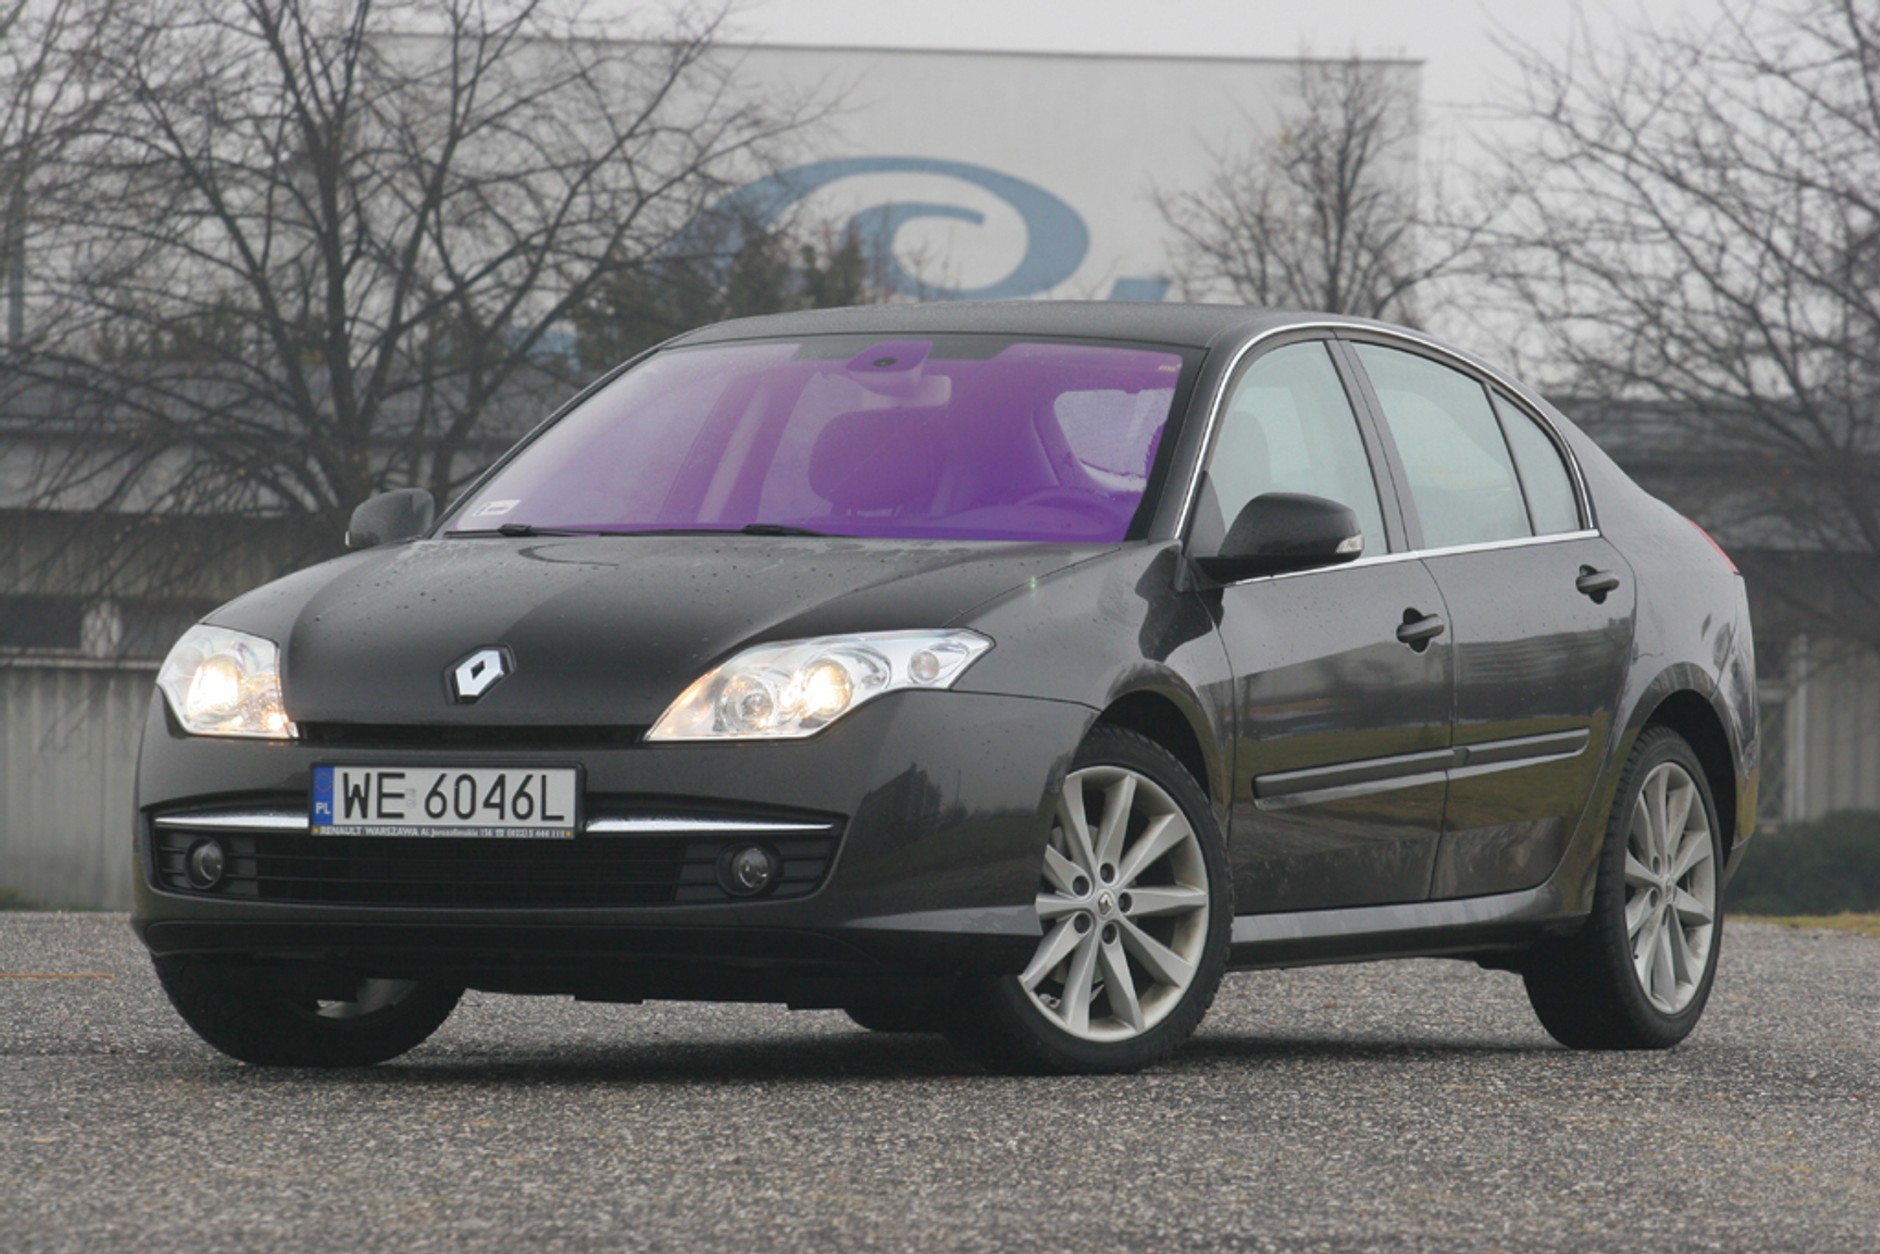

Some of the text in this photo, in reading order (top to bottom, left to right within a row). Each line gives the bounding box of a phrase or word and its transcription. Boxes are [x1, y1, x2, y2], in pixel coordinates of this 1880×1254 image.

[315, 802, 331, 815] PL
[343, 772, 565, 821] WE 6046L
